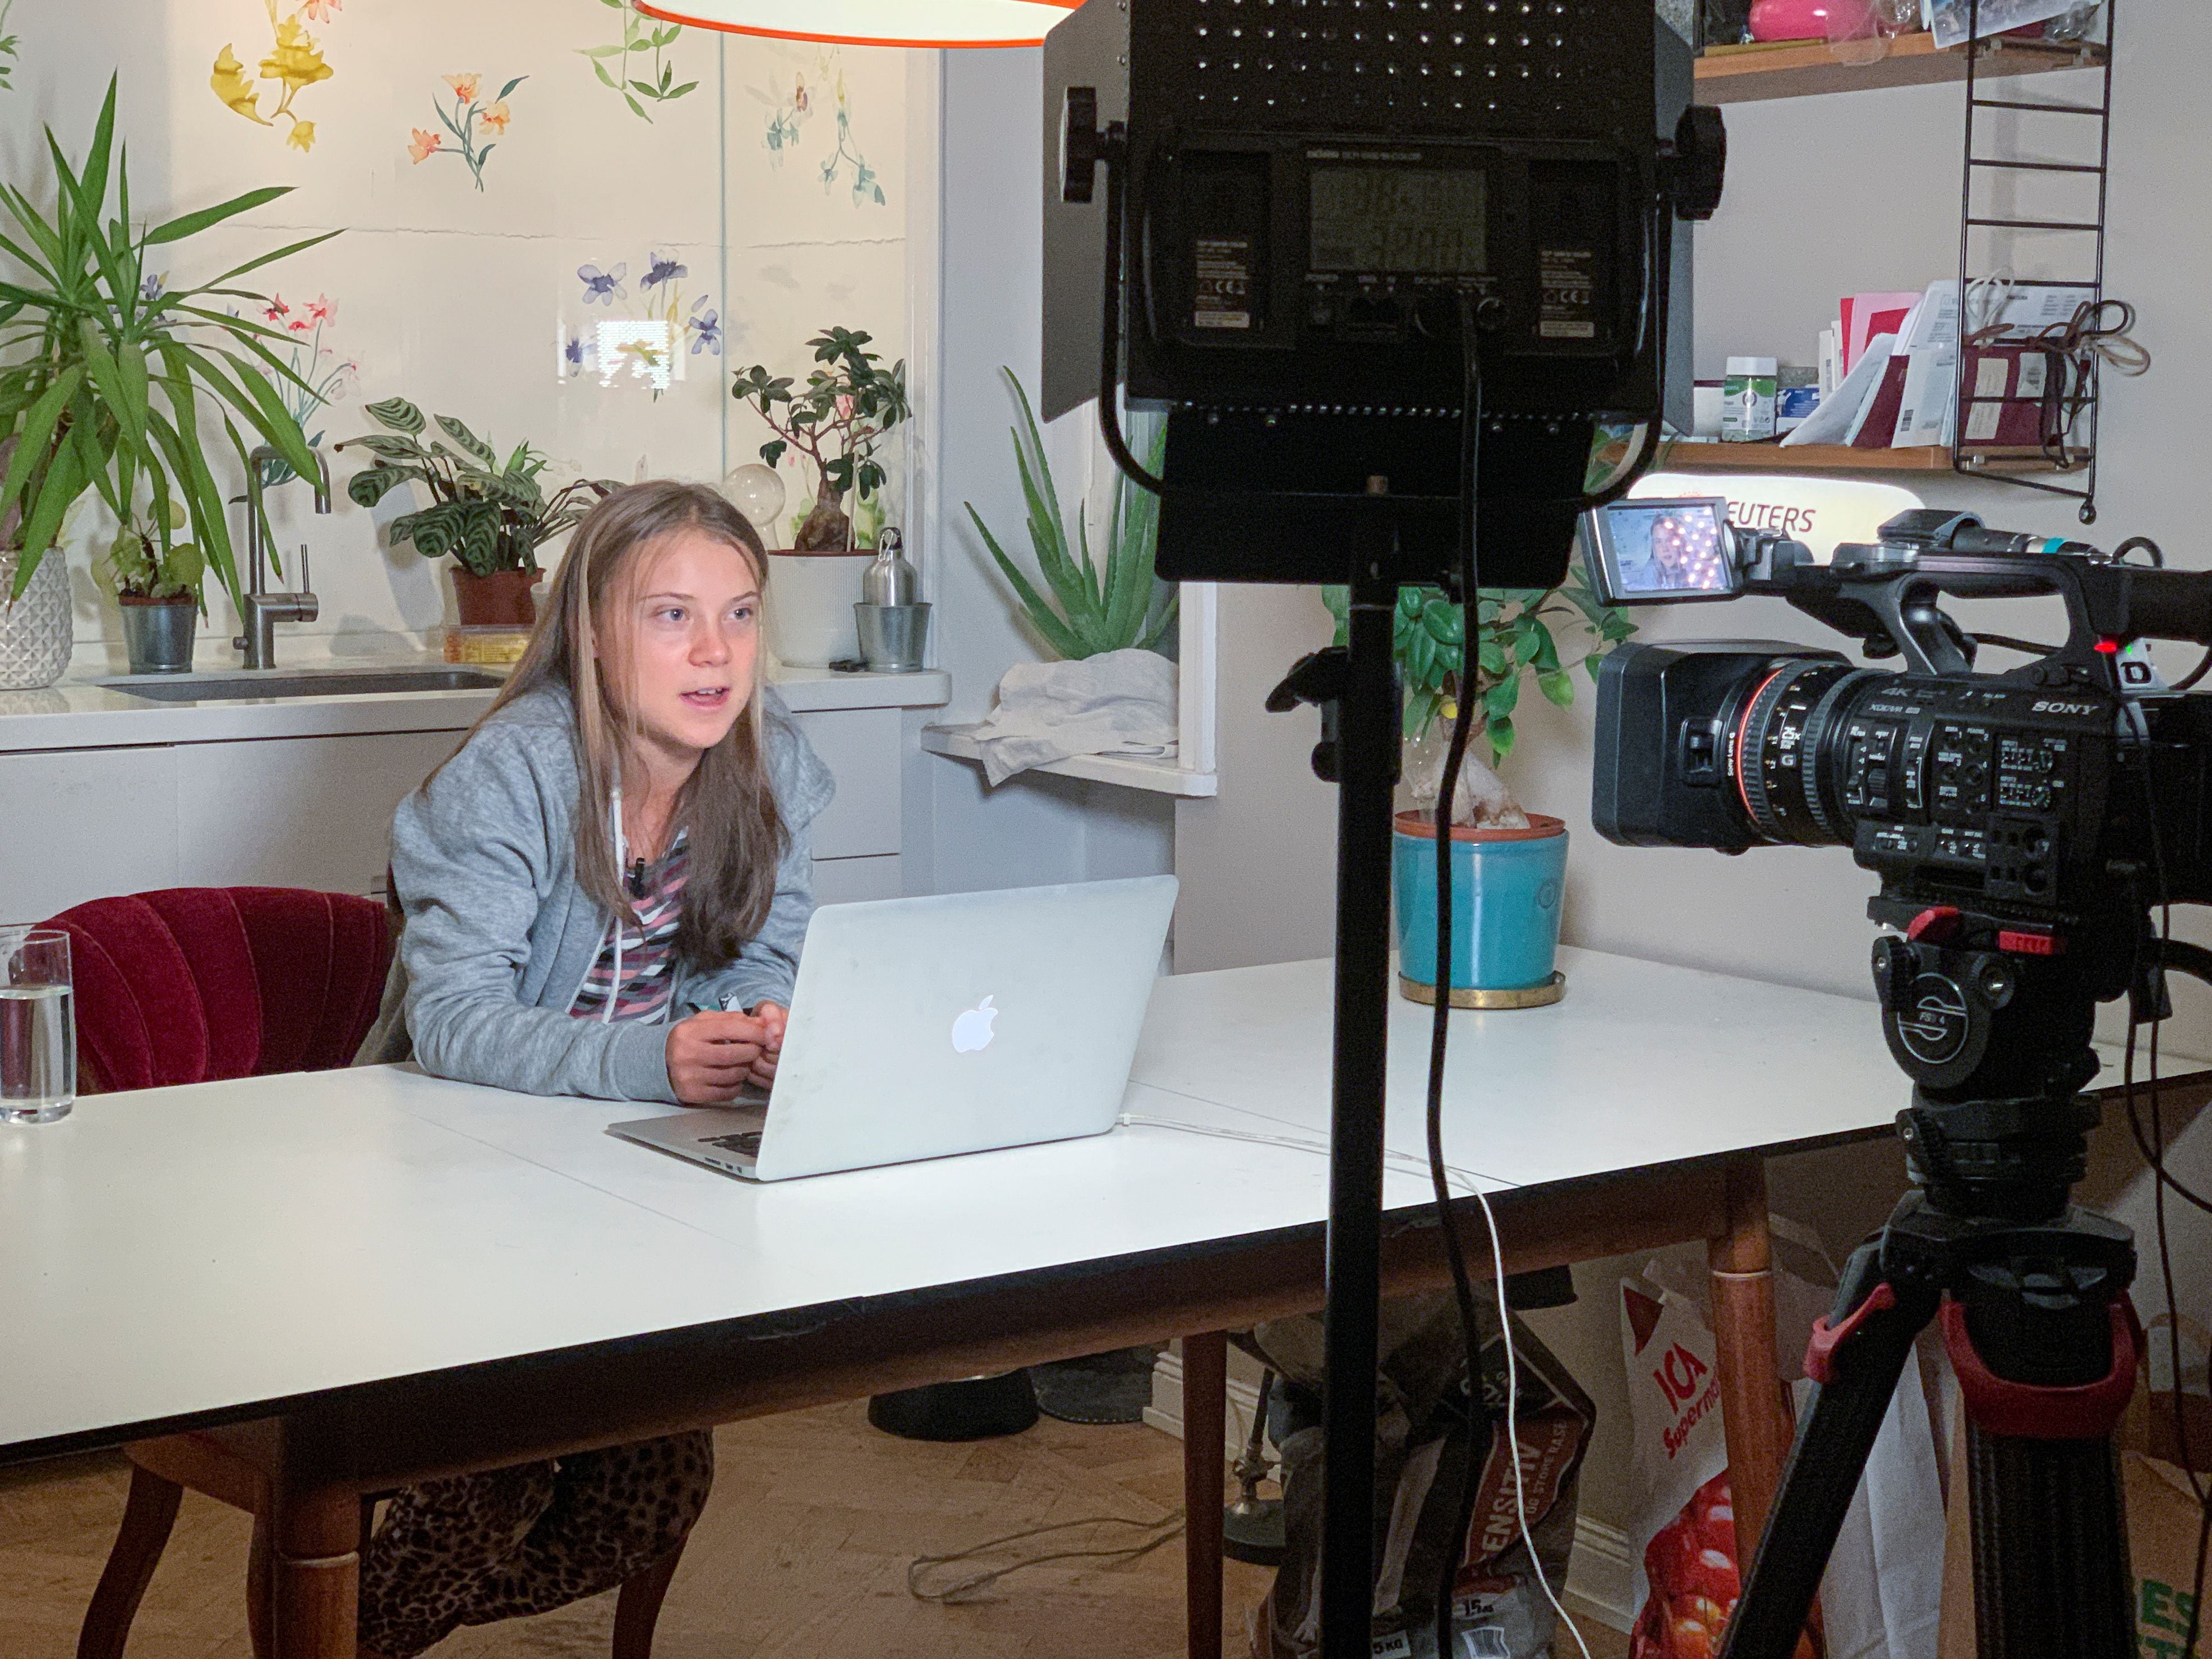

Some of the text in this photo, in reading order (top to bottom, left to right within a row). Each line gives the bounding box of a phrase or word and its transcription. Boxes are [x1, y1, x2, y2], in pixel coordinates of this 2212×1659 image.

[1727, 501, 1816, 532] EUTERS
[2031, 701, 2099, 715] SONY
[1653, 1342, 1707, 1415] ICA
